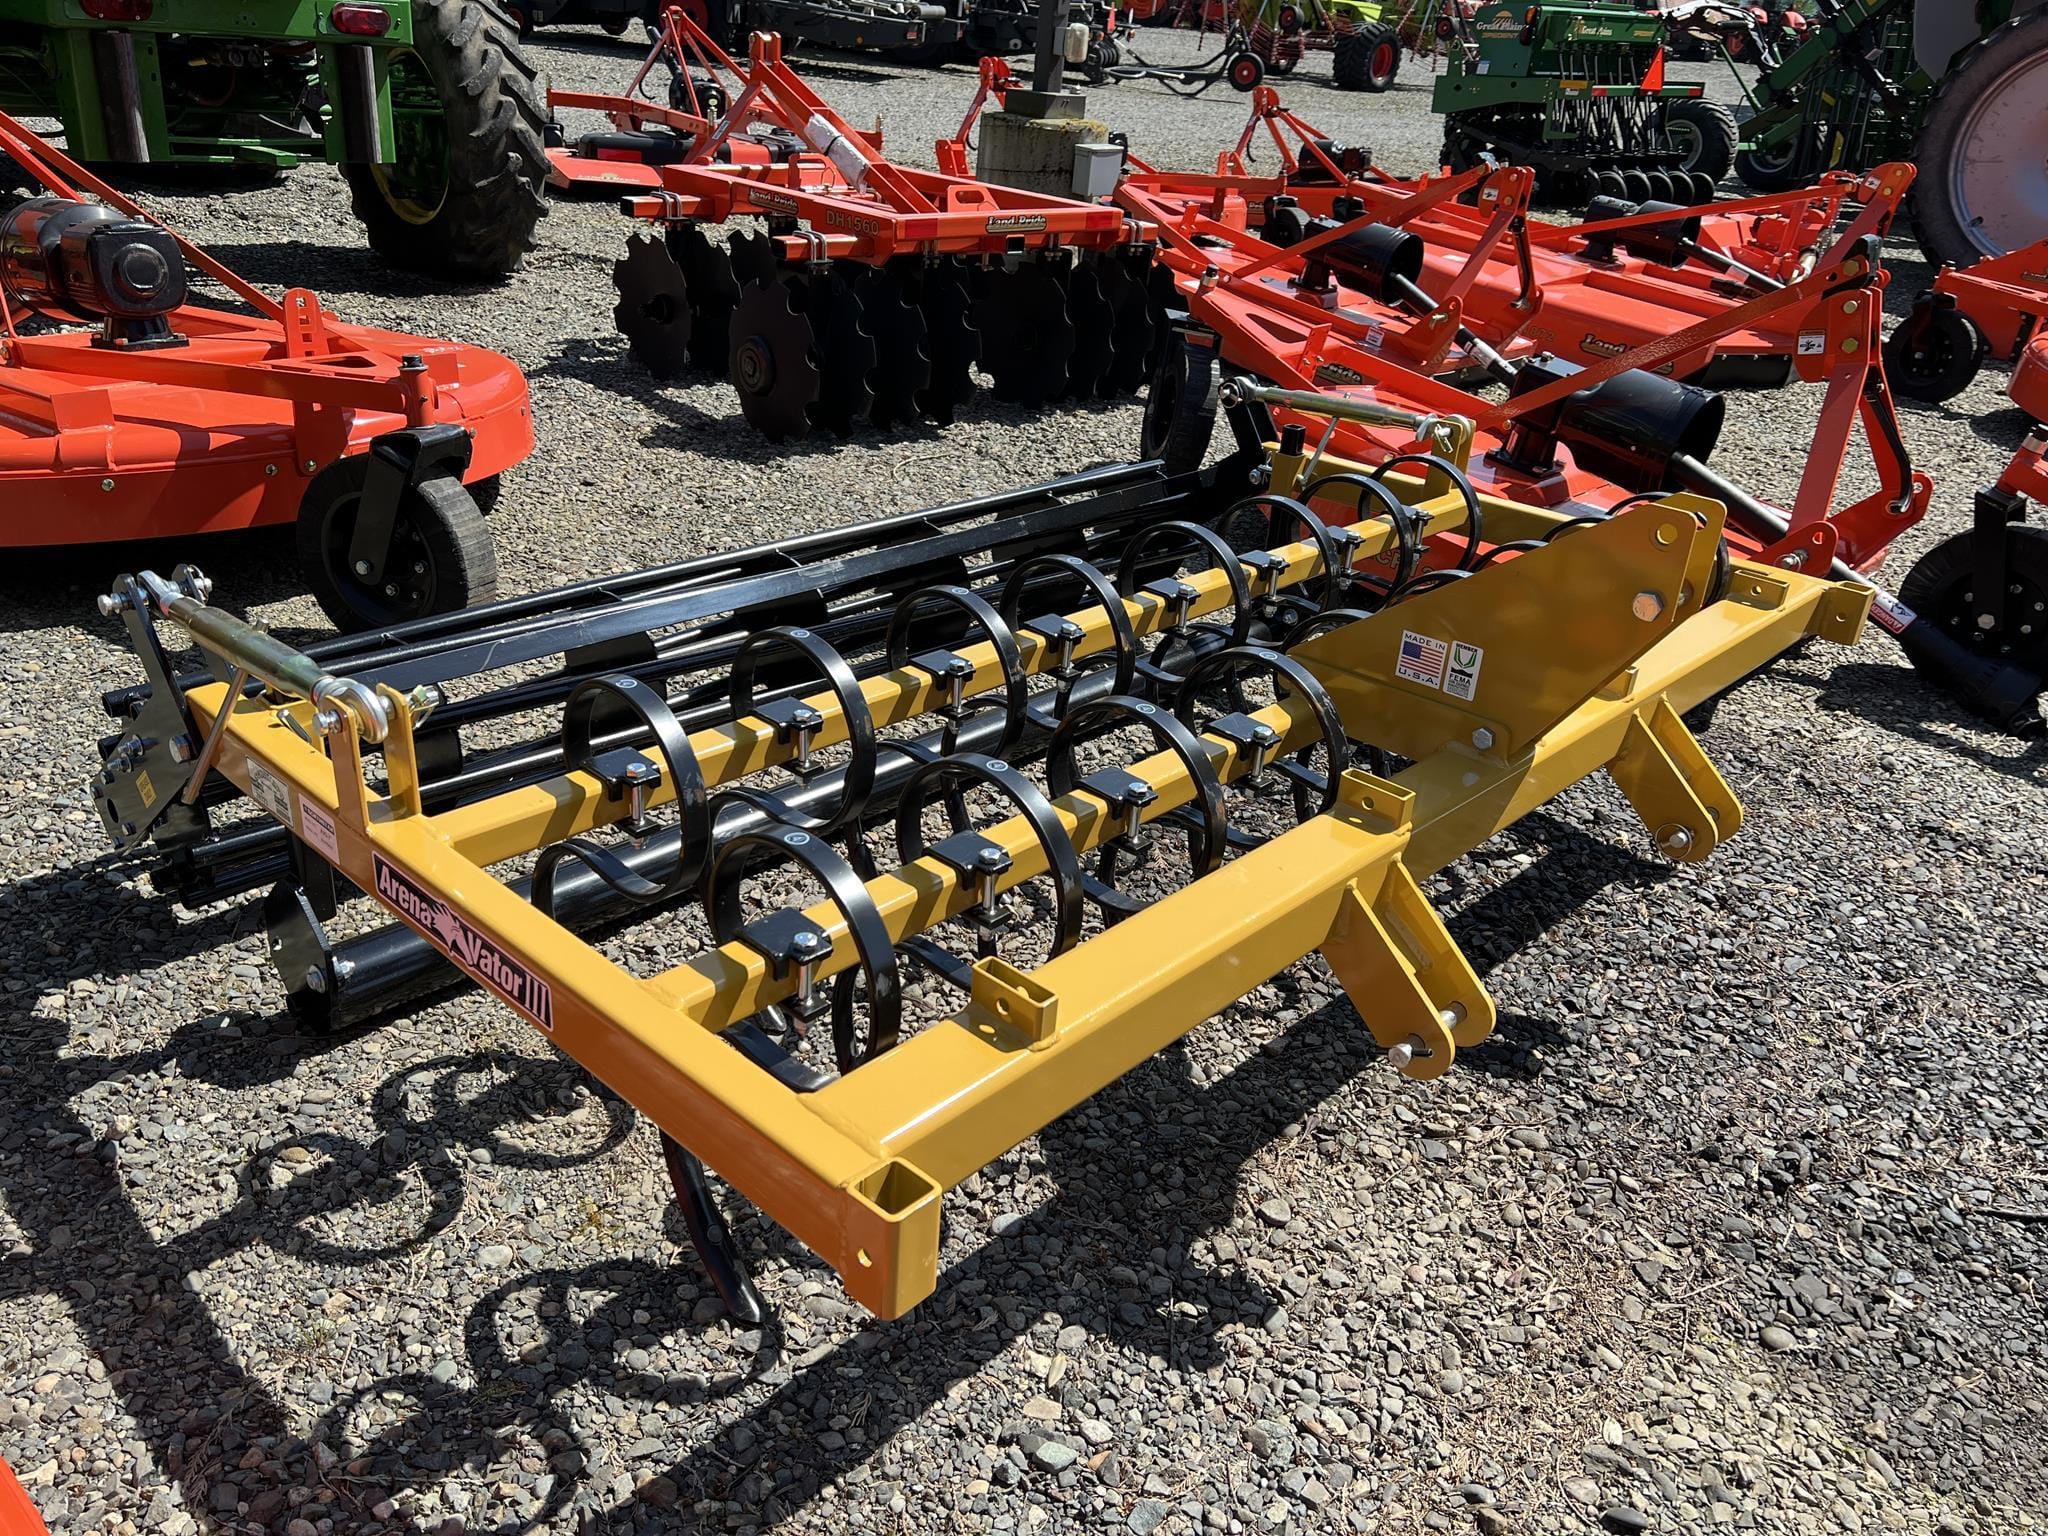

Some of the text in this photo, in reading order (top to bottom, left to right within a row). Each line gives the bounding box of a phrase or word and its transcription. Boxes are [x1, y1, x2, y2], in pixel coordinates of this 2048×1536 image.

[826, 209, 879, 236] DH1560
[988, 215, 1046, 225] Land Pride
[1585, 333, 1626, 353] Land
[1323, 363, 1361, 383] ride
[1404, 633, 1446, 651] MADE IN
[1455, 643, 1478, 653] MEMBER
[1398, 667, 1438, 686] U.S.A.
[1449, 673, 1471, 685] FEMA
[379, 864, 434, 929] Arena
[465, 930, 524, 998] Vator
